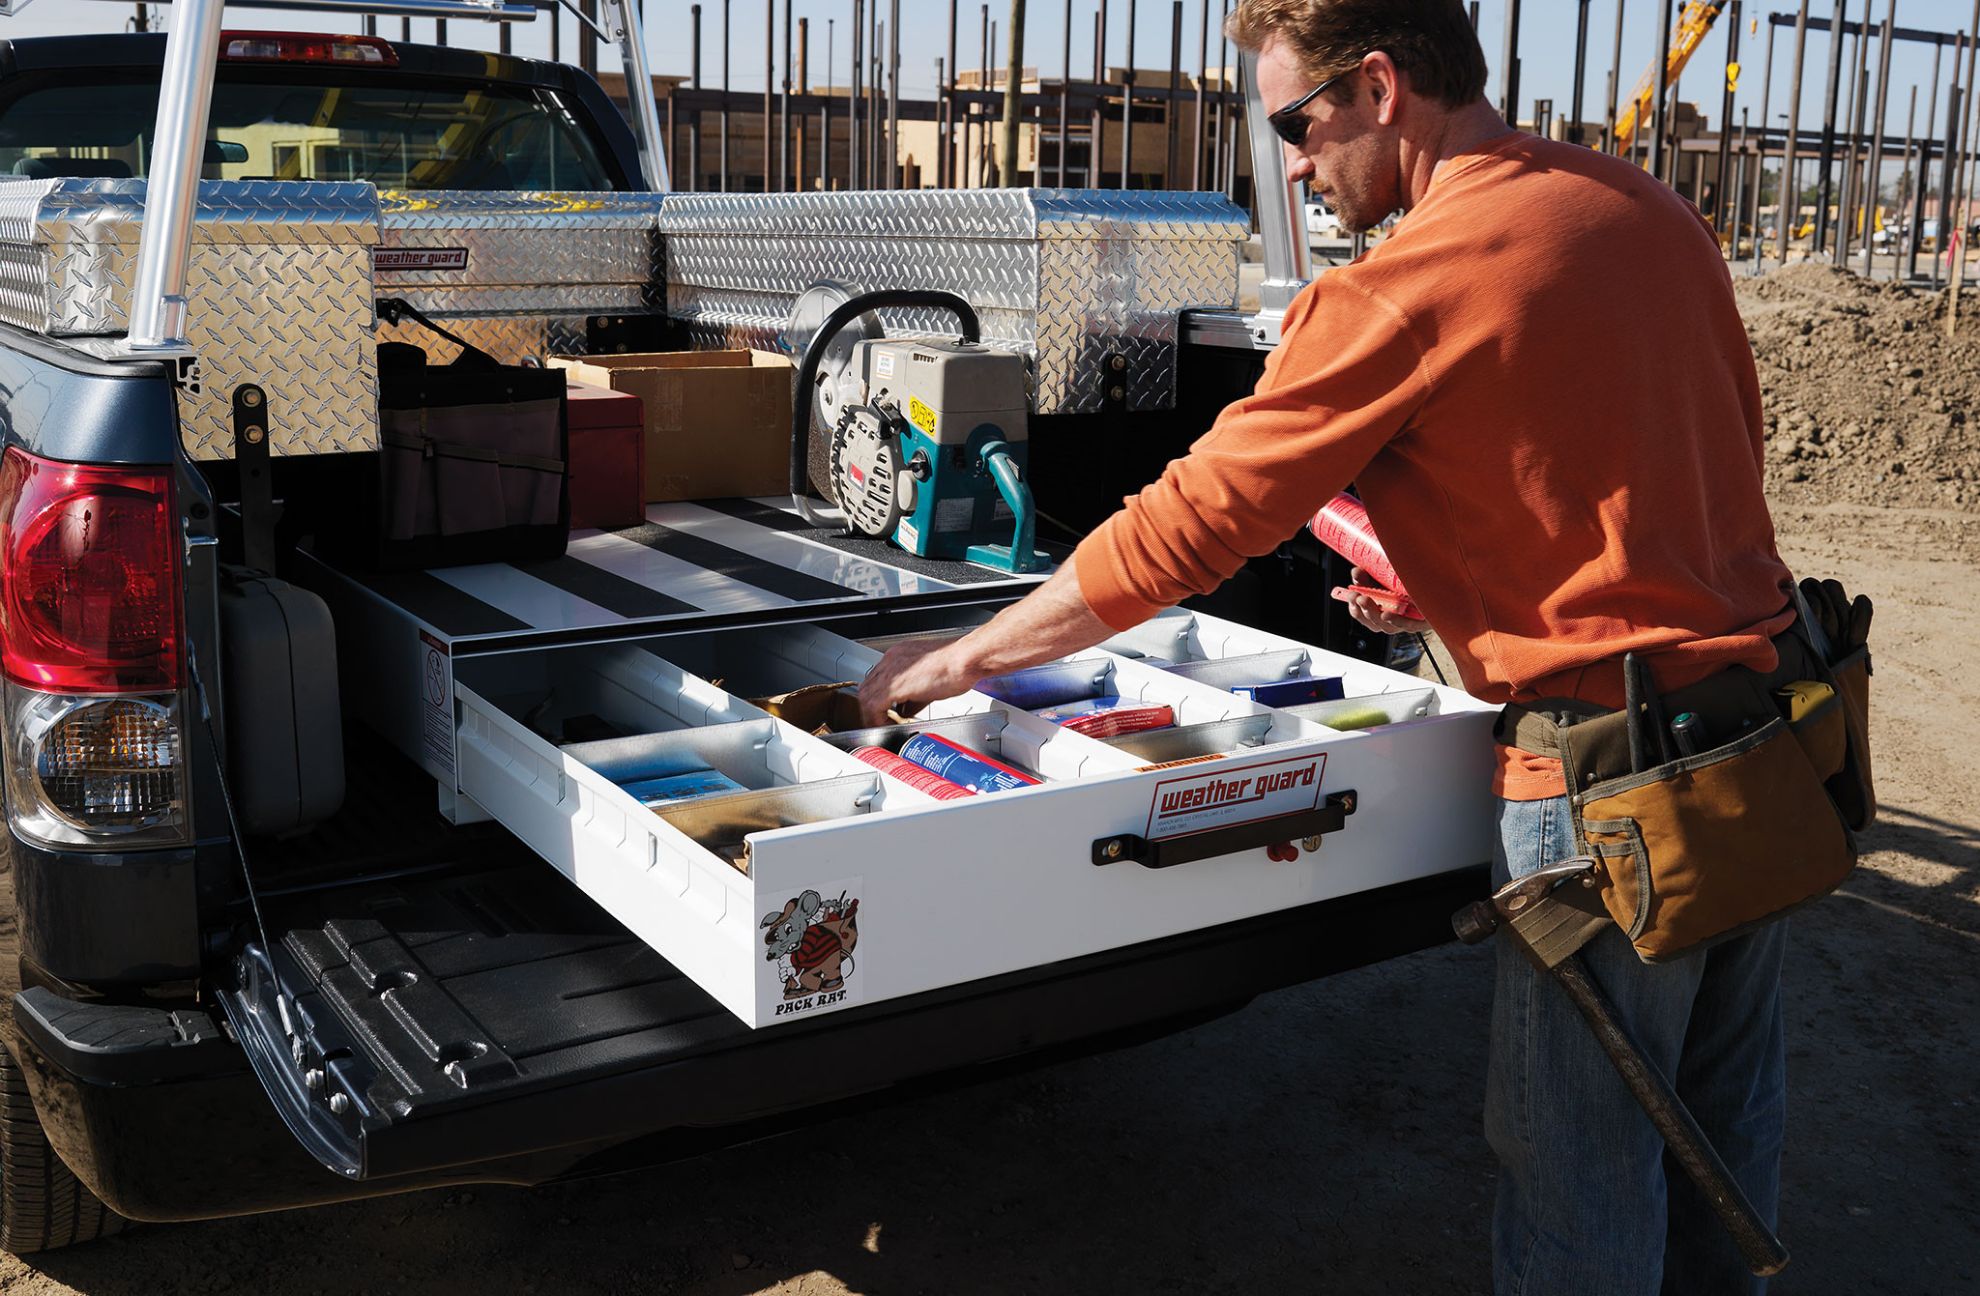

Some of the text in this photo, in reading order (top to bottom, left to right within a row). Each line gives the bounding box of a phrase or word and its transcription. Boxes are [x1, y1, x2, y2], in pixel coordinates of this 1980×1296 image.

[375, 251, 463, 267] weather guard
[1160, 762, 1317, 813] weather guard
[775, 997, 814, 1016] PACK
[817, 989, 847, 1007] RAT
